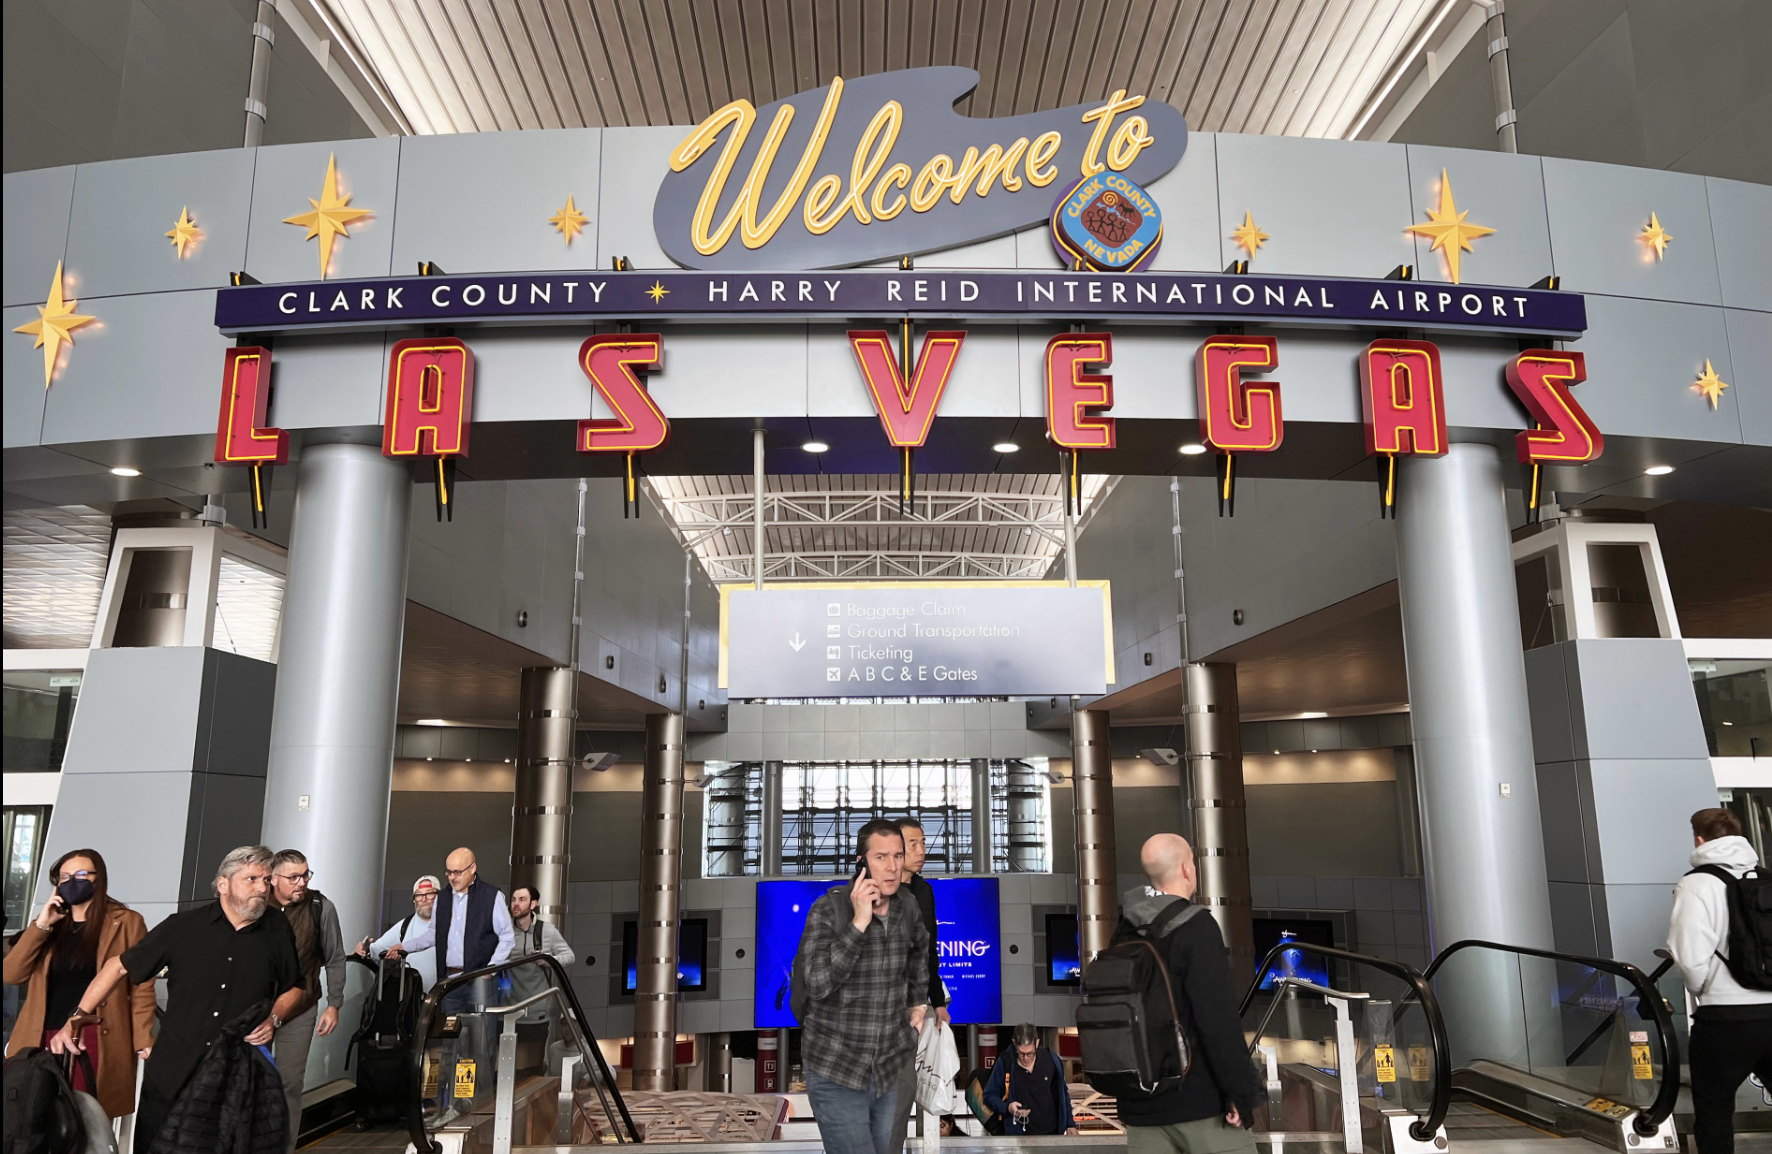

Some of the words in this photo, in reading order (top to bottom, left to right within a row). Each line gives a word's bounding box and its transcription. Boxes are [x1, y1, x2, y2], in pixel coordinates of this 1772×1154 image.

[669, 76, 1061, 255] Welcome
[1080, 89, 1154, 177] to
[1068, 178, 1104, 217] CLARK
[1106, 176, 1156, 218] COUNTY
[1084, 238, 1144, 264] NEVADA
[278, 287, 404, 314] CLARK
[431, 281, 607, 307] COUNTY
[708, 280, 841, 302] HARRY
[887, 280, 979, 302] REID
[1017, 281, 1334, 308] INTERNATIONAL
[1370, 289, 1528, 318] AIRPORT
[214, 333, 669, 465] LAS
[849, 329, 1604, 465] VEGAS
[847, 603, 915, 620] Baggage
[921, 602, 966, 616] Claim
[847, 623, 907, 638] Ground
[912, 623, 1020, 640] Transportation
[848, 644, 913, 663] Ticketing
[847, 667, 860, 682] A
[866, 666, 876, 682] B
[881, 665, 895, 682] C
[900, 666, 912, 682] &
[918, 665, 927, 681] E
[933, 665, 978, 681] Gates
